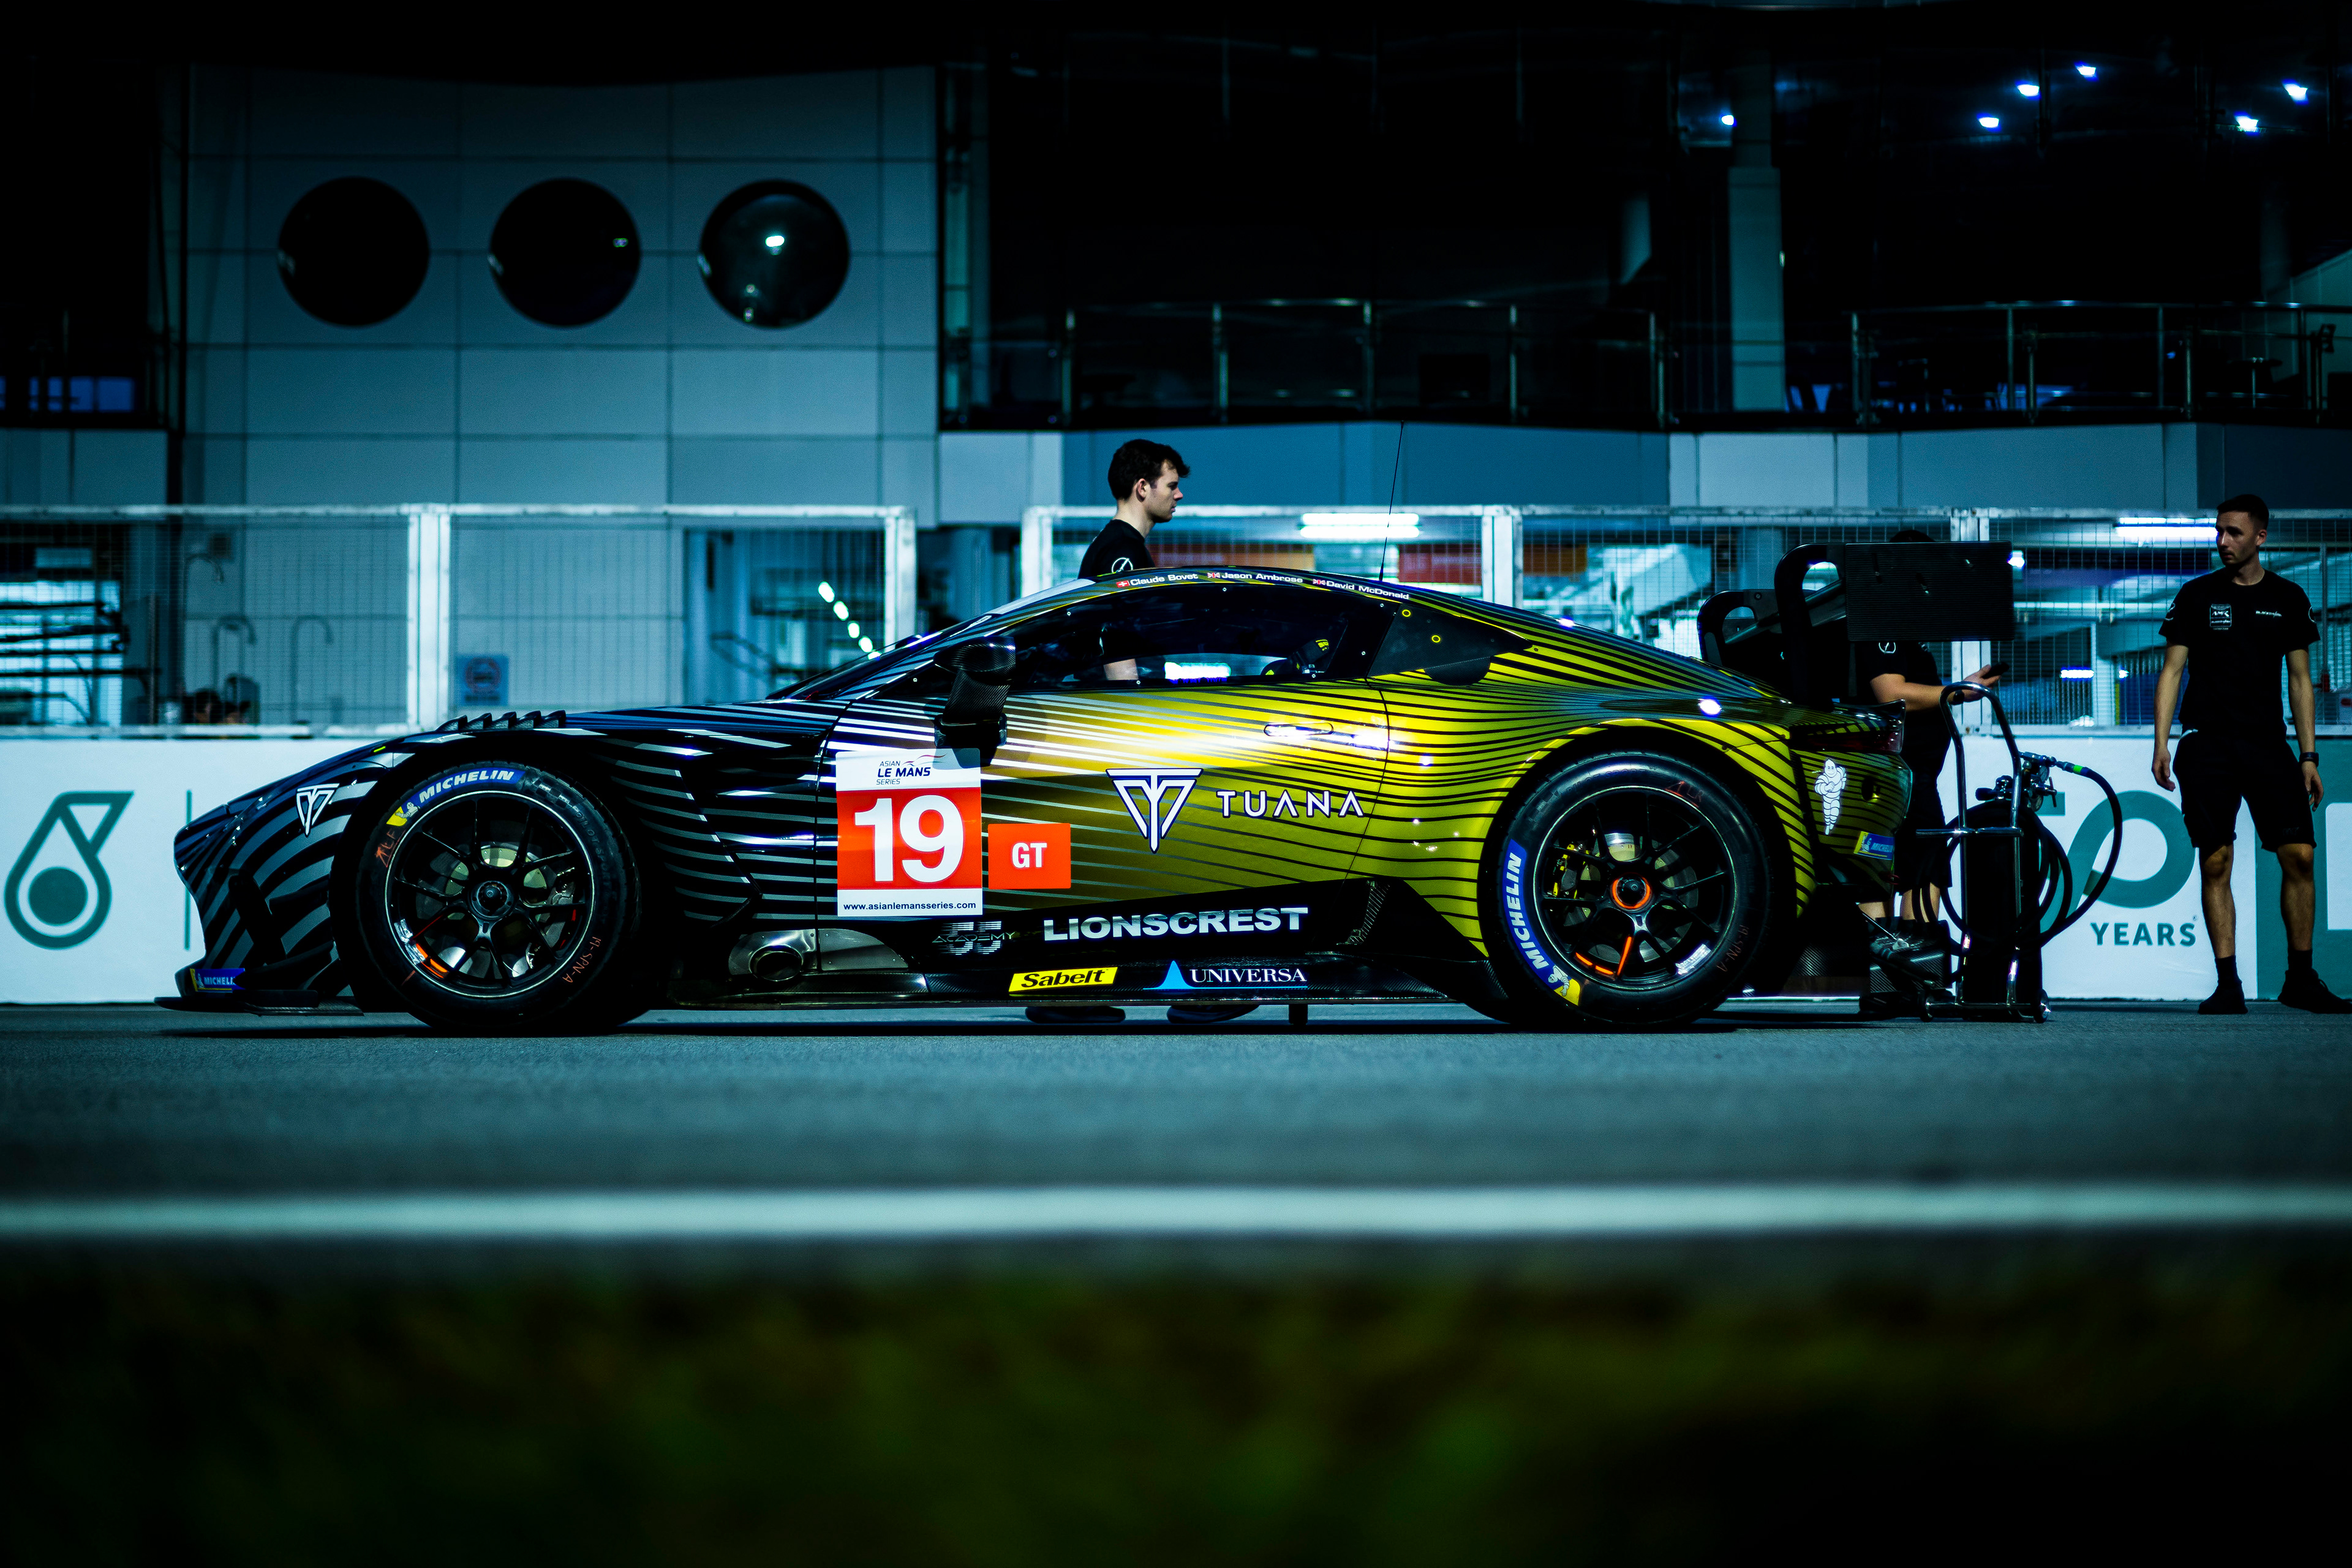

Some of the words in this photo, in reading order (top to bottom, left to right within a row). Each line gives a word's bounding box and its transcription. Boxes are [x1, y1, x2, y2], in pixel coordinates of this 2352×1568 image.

[1130, 576, 1165, 586] Claude
[1256, 573, 1303, 583] Ambrose
[1326, 580, 1355, 590] David
[1359, 586, 1409, 600] McDonald
[878, 768, 892, 777] LE
[895, 767, 931, 777] MANS
[419, 769, 514, 801] MICHELIN
[1217, 790, 1363, 818] TUANA
[854, 794, 964, 883] 19
[1012, 842, 1047, 869] GT
[843, 900, 976, 912] www.asianlemansseries.com
[1504, 852, 1548, 969] MICHELIN
[1043, 907, 1309, 941] LIONSCREST
[932, 931, 1016, 943] ACADEMY
[2090, 922, 2196, 946] YEARS
[203, 976, 238, 986] MICHELI
[1021, 969, 1106, 987] Sabelt
[1191, 968, 1307, 982] UNIVERSA
